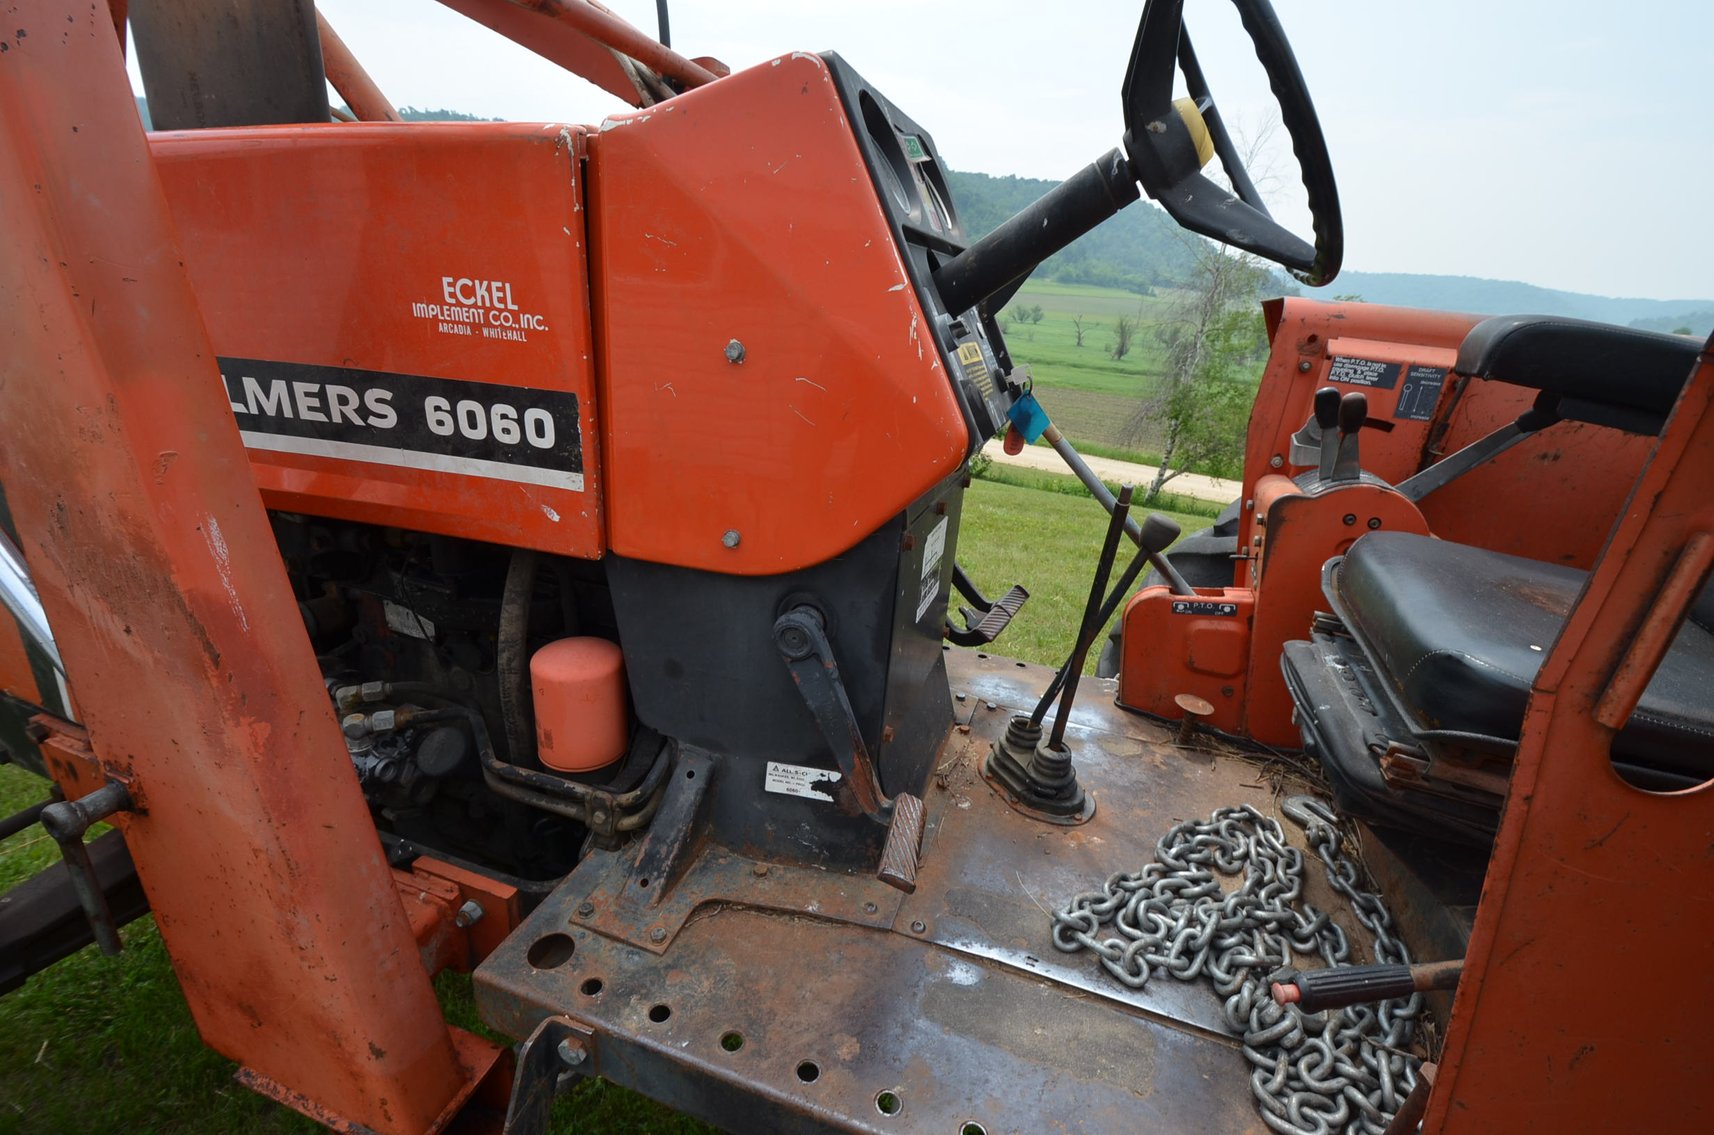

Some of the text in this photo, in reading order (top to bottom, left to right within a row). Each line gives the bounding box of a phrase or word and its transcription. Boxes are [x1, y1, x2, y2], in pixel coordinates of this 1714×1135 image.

[442, 276, 518, 310] ECKEL
[412, 302, 484, 324] IMPLEMENT
[438, 322, 472, 336] ARCADIA
[482, 326, 527, 342] WHITEHALL
[424, 396, 556, 449] 6060
